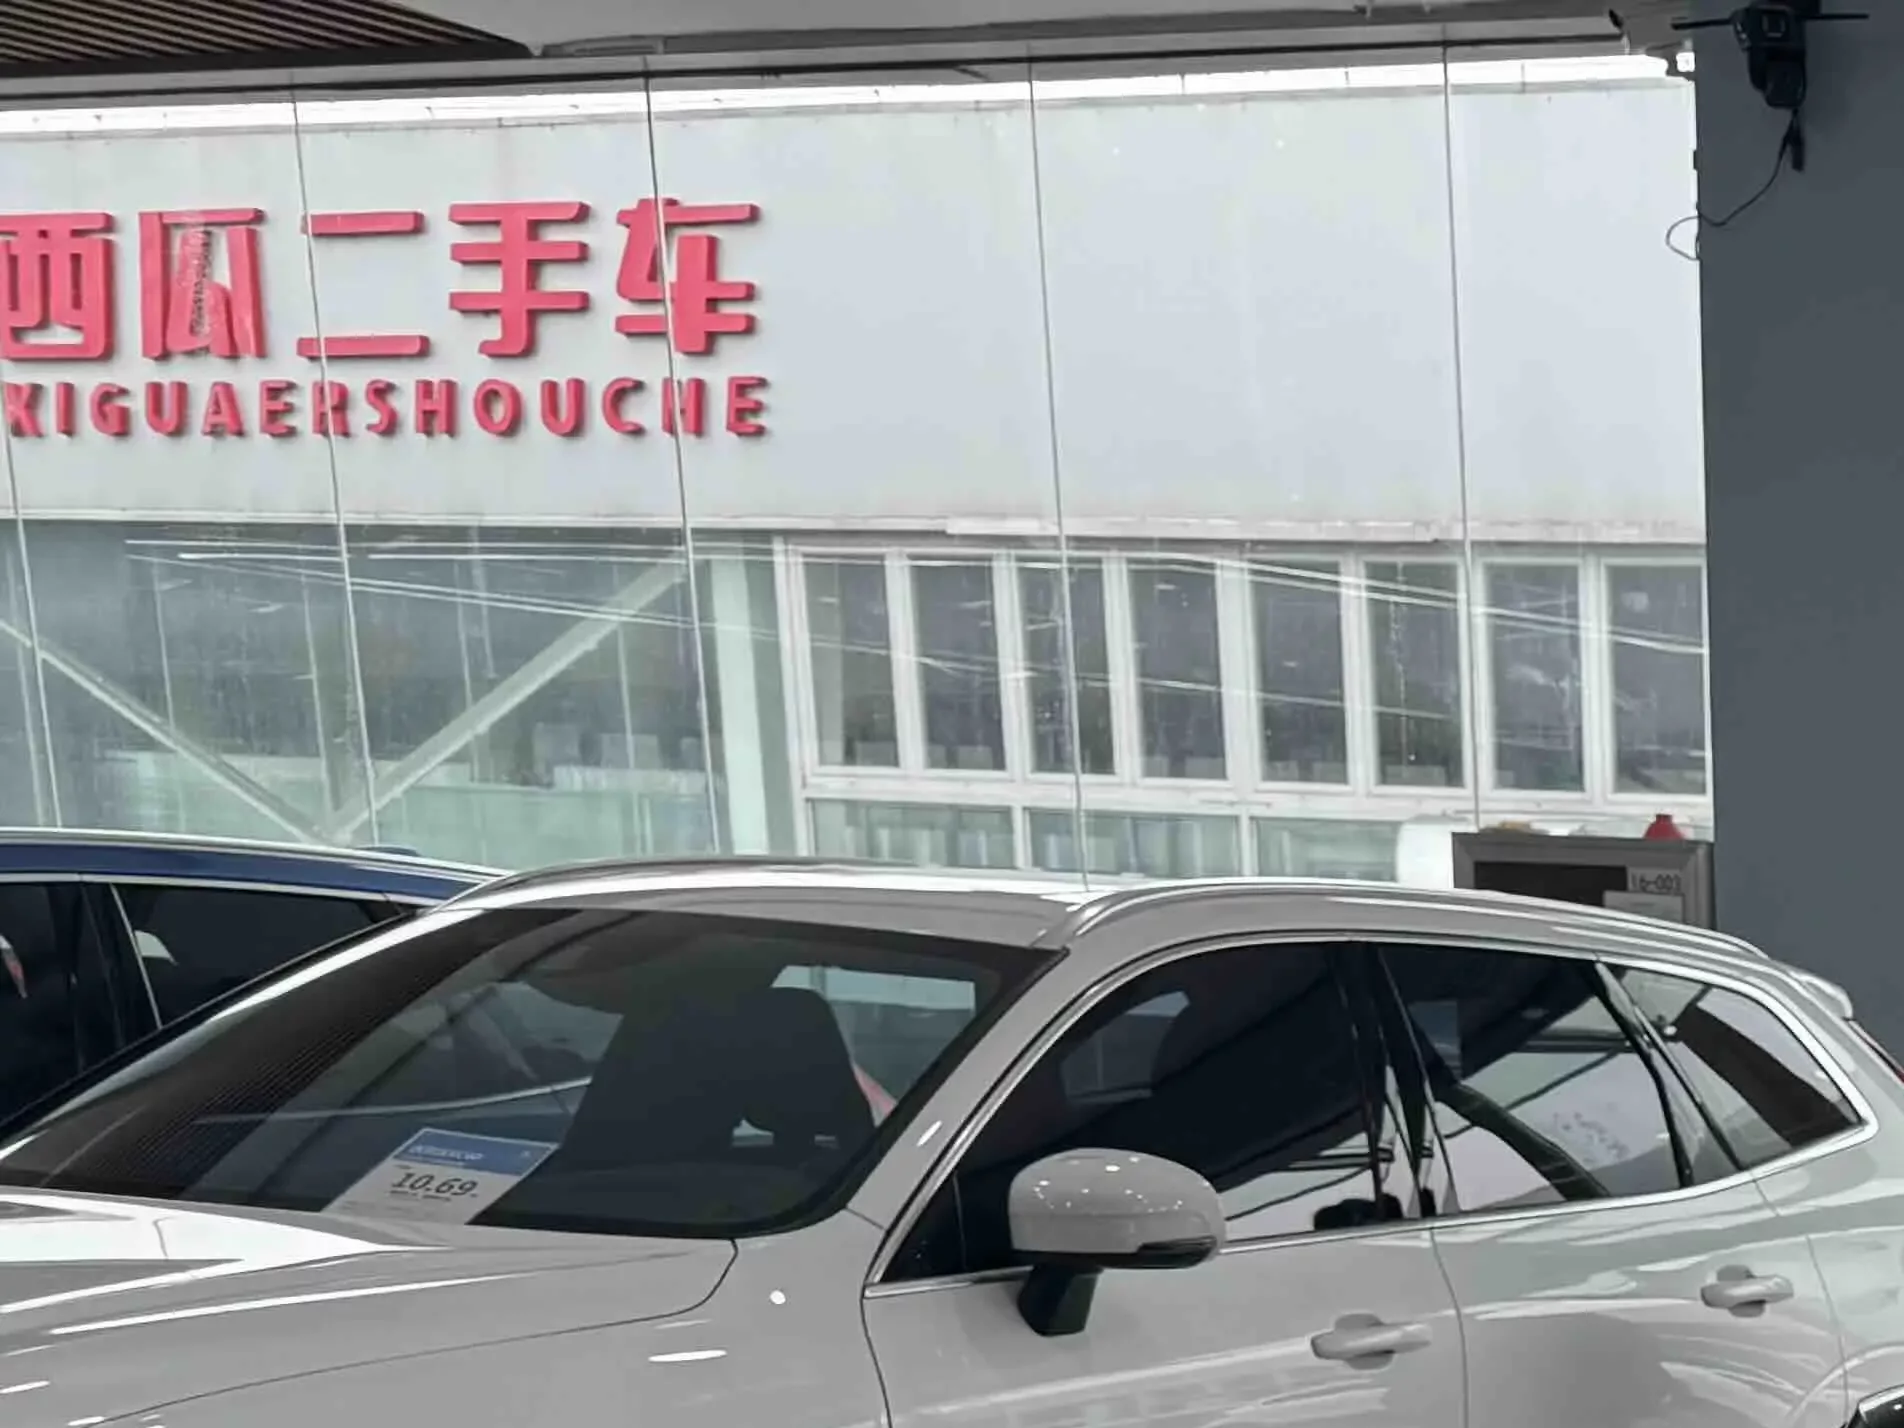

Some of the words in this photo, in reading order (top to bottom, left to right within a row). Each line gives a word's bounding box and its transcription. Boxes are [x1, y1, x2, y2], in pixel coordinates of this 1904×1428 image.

[0, 197, 762, 362] 西瓜二手车
[5, 375, 768, 440] XIGUAERSHOUCHE
[390, 1172, 478, 1197] 10.69
